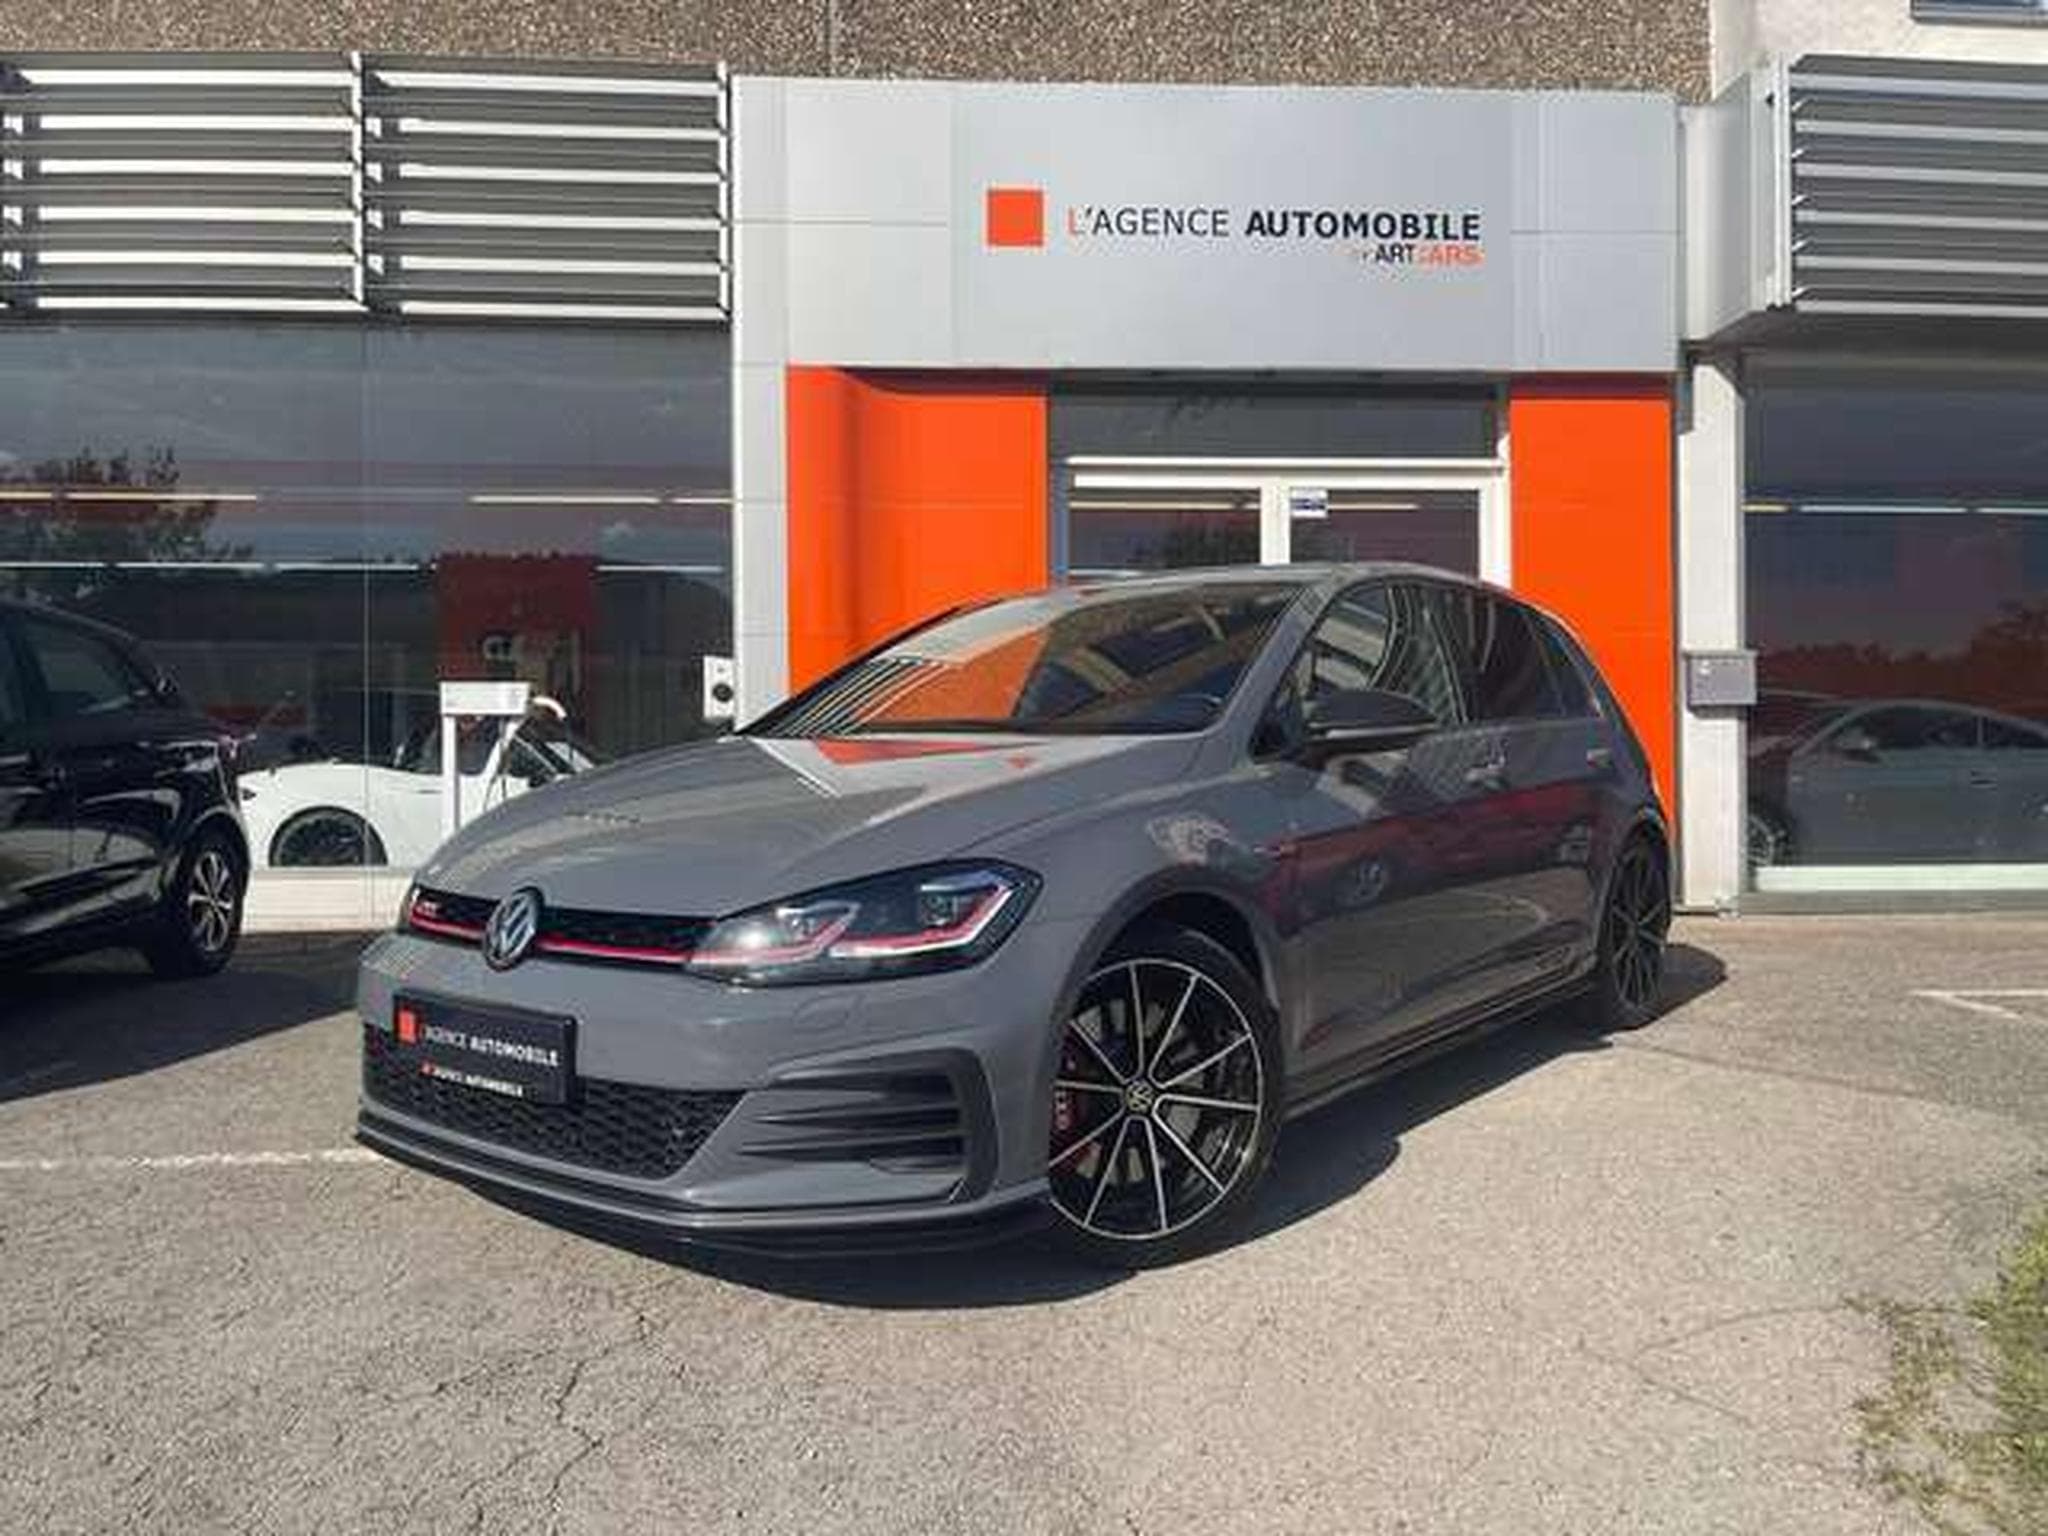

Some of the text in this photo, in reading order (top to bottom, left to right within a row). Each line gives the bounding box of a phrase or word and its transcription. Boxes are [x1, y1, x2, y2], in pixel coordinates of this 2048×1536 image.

[1067, 207, 1481, 241] L'AGENCE AUTOMOBILE
[470, 1035, 559, 1067] AUTOMOBILE
